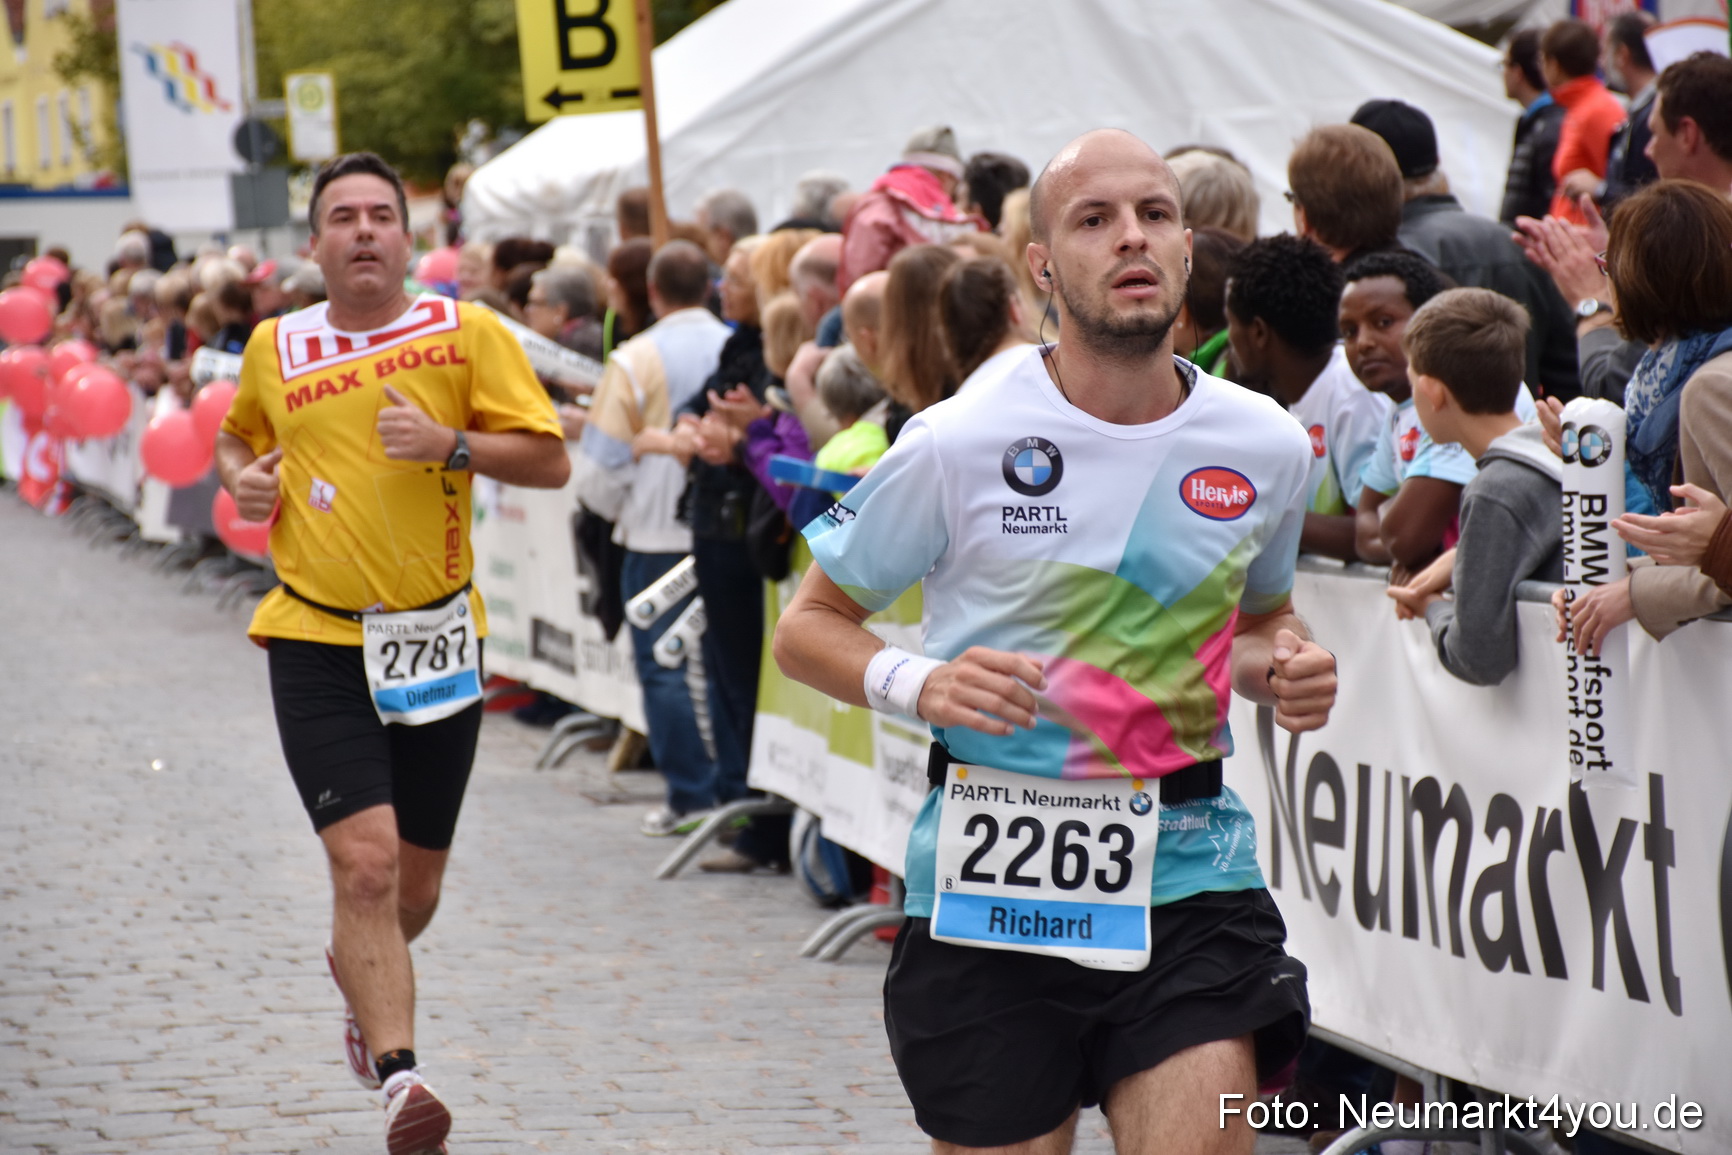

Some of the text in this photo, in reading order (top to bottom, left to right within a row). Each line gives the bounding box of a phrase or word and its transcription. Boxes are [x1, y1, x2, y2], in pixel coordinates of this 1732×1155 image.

[555, 0, 617, 70] B
[285, 343, 467, 413] MAX BÖGL
[1007, 437, 1059, 458] BMW
[1191, 478, 1248, 507] Hervis
[1002, 506, 1067, 521] PARTL
[1002, 522, 1068, 534] Neumarkt
[1580, 494, 1609, 587] BMW
[367, 623, 411, 635] PARTL
[381, 625, 465, 681] 2787
[406, 683, 458, 707] Dietmar
[950, 783, 1017, 805] PARTL
[1022, 789, 1122, 811] Neumarkt
[960, 813, 1135, 893] 2263
[1256, 703, 1683, 1017] Neumarkt
[945, 878, 953, 889] B
[988, 907, 1093, 940] Richard
